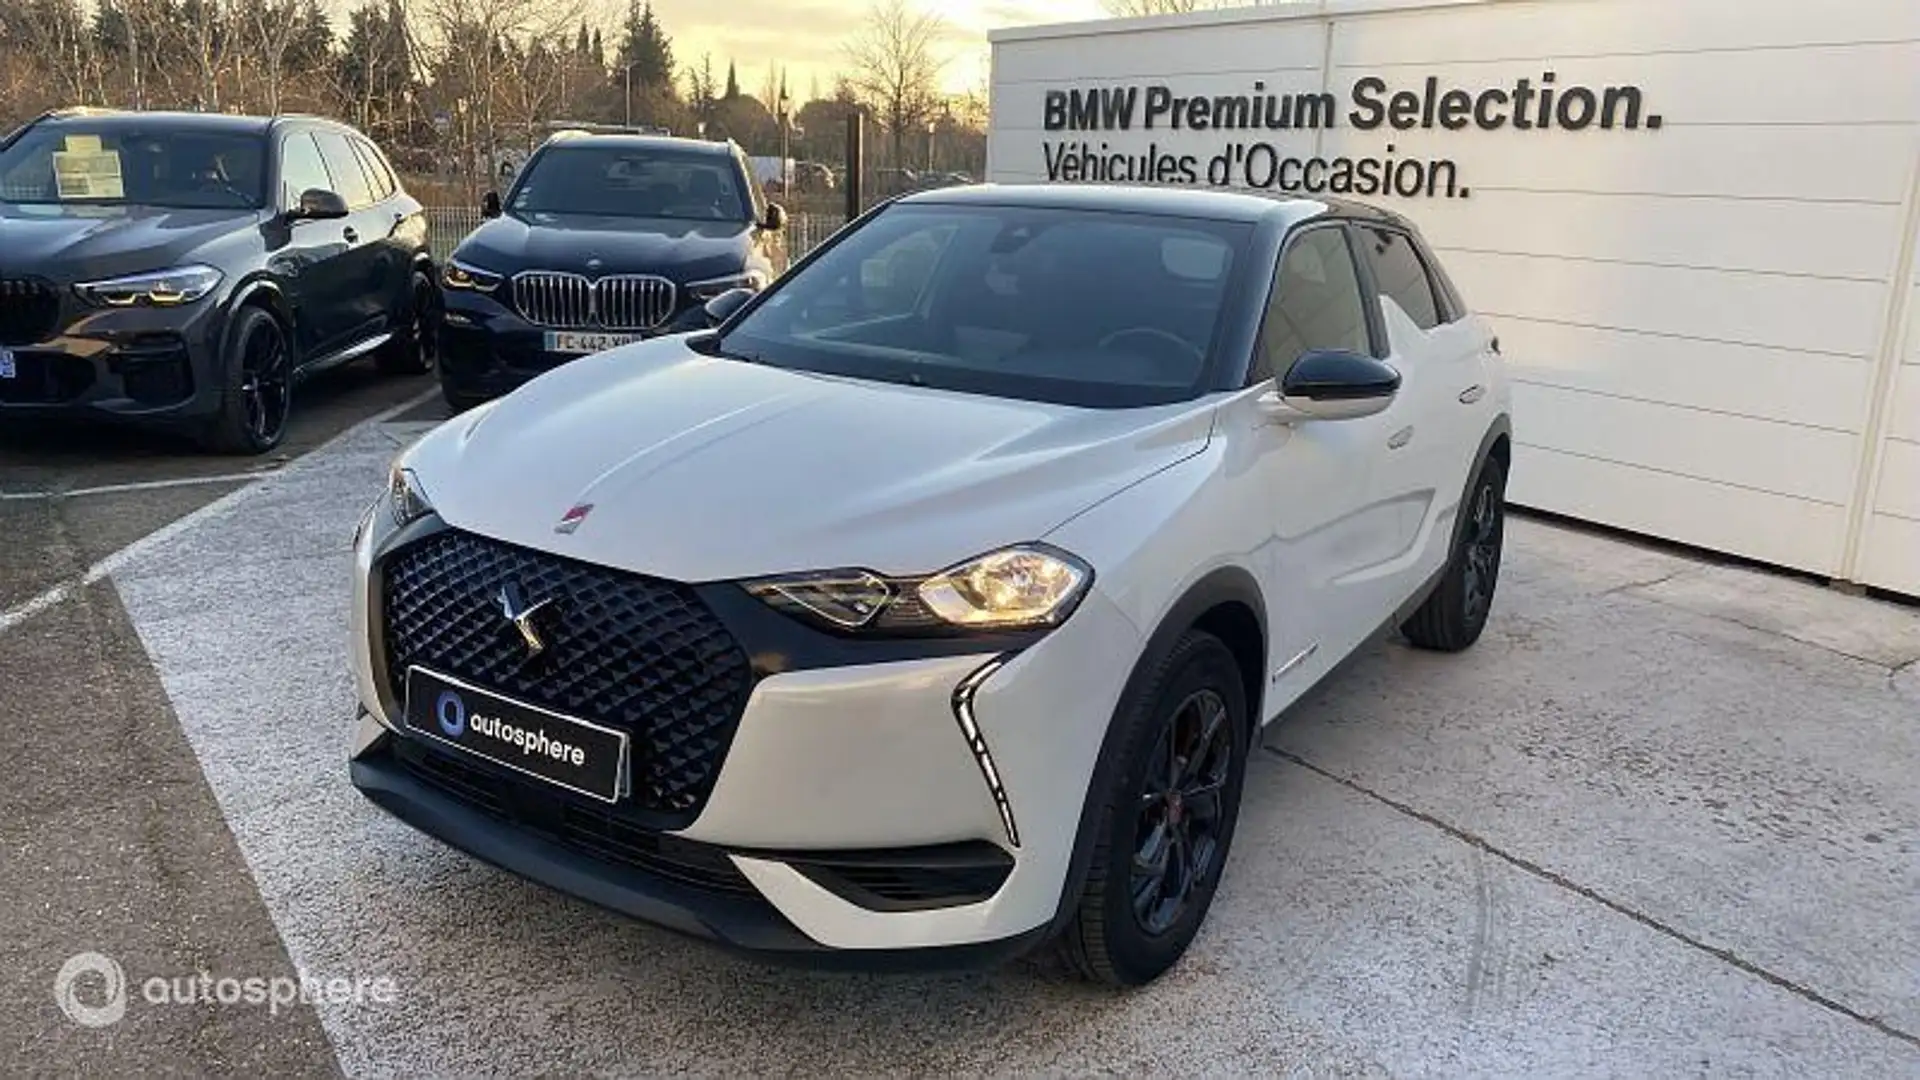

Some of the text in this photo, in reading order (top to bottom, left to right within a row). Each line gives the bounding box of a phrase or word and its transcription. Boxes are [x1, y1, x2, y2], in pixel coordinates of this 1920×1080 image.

[1044, 72, 1662, 130] BMW Premium Selection.
[1043, 141, 1470, 198] Véhicules d'Occasion.
[470, 714, 585, 766] autosphere
